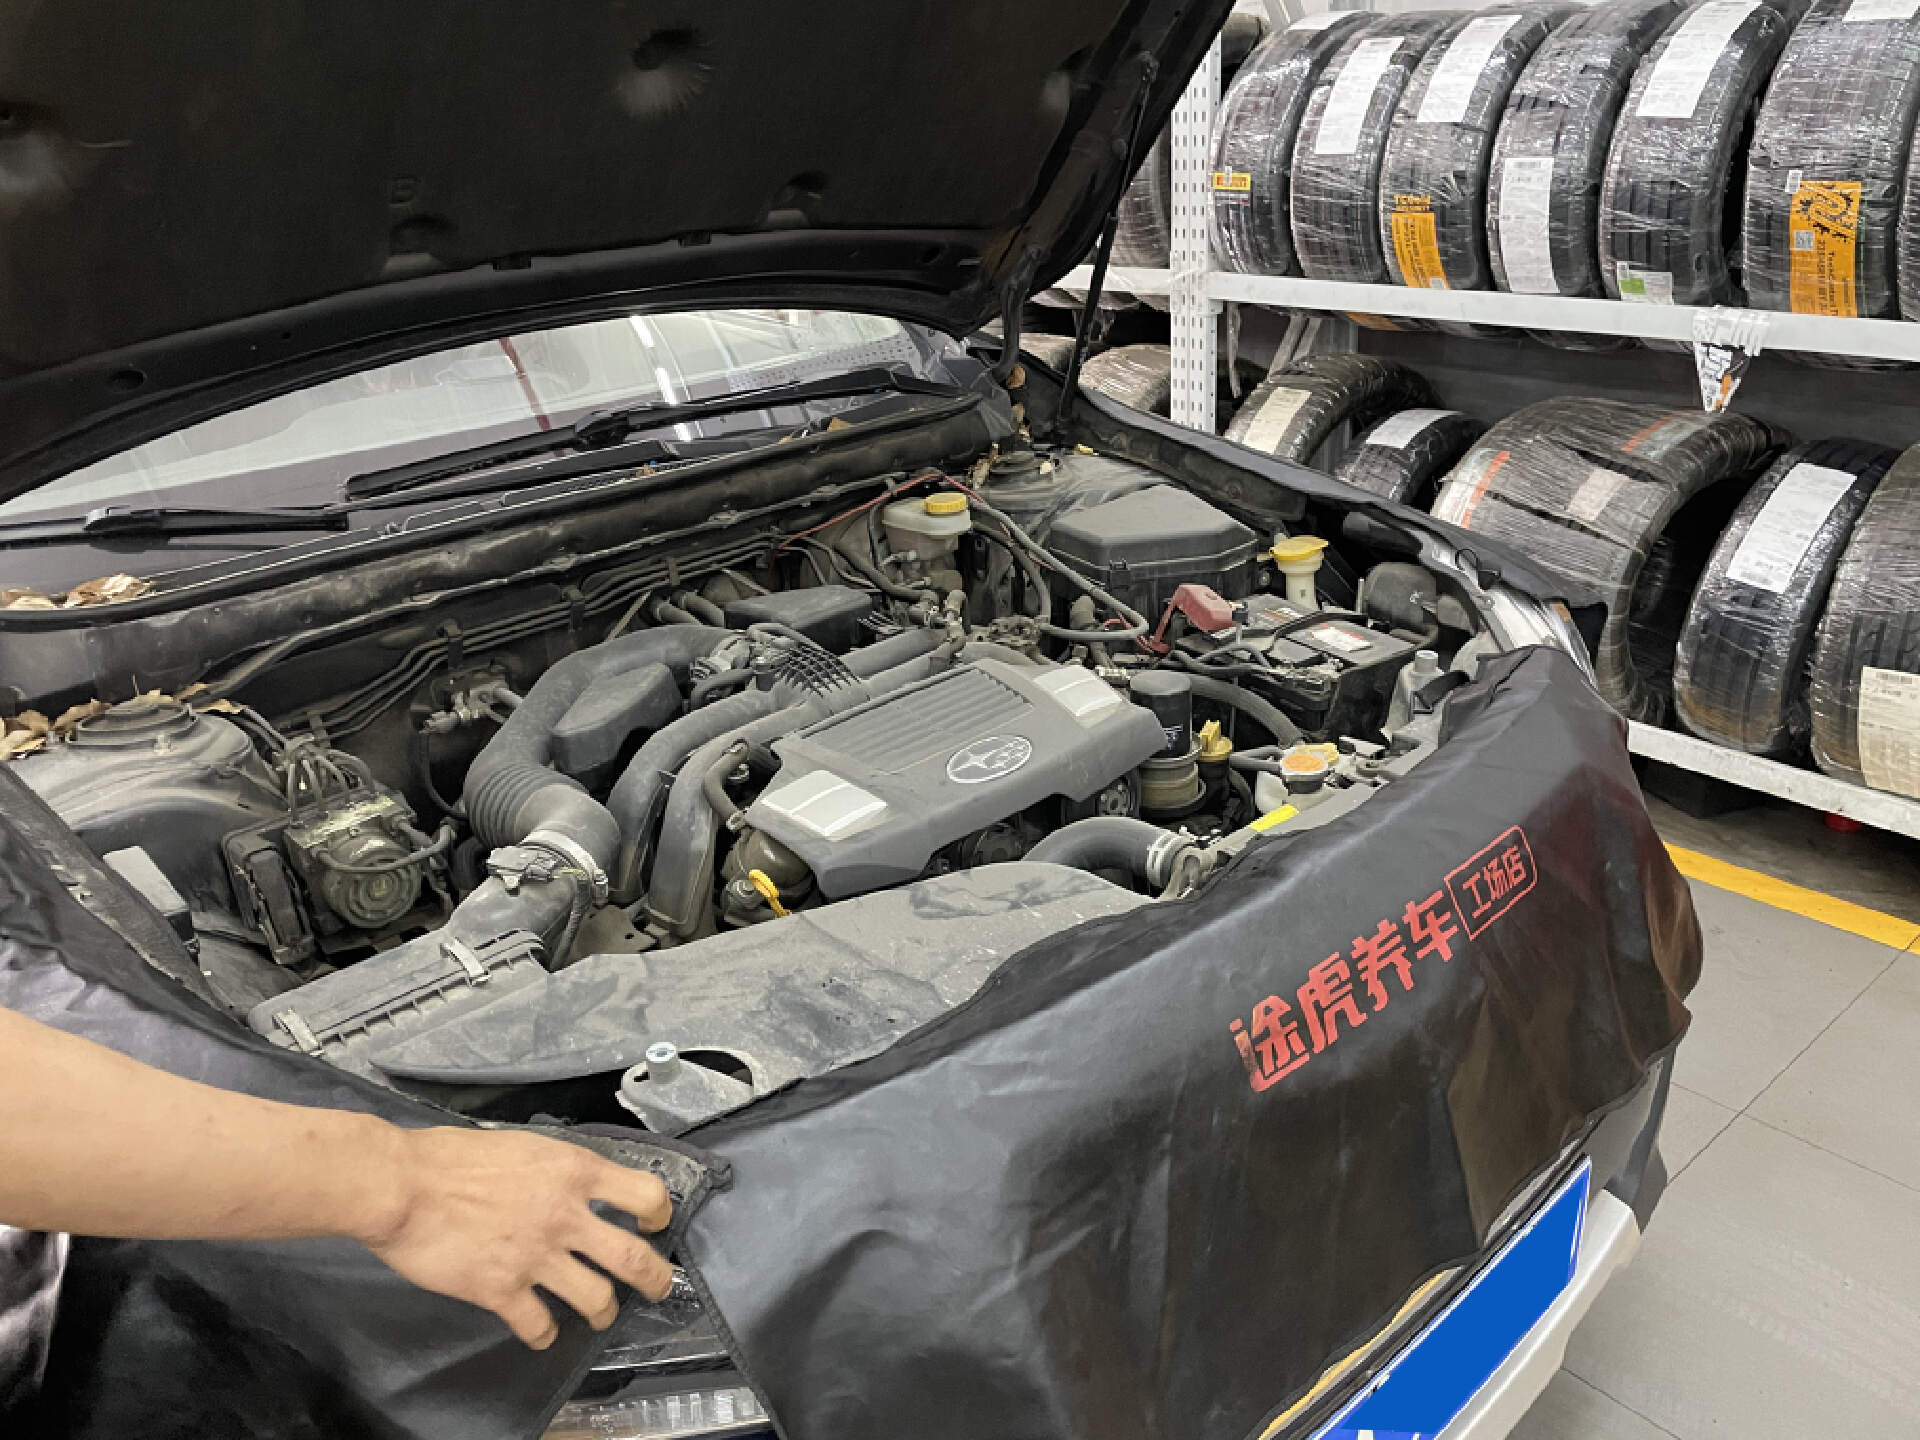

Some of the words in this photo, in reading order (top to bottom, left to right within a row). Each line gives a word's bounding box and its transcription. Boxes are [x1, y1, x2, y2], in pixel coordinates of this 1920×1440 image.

[1229, 890, 1458, 1092] 途虎养车
[1462, 846, 1527, 919] 工场店
